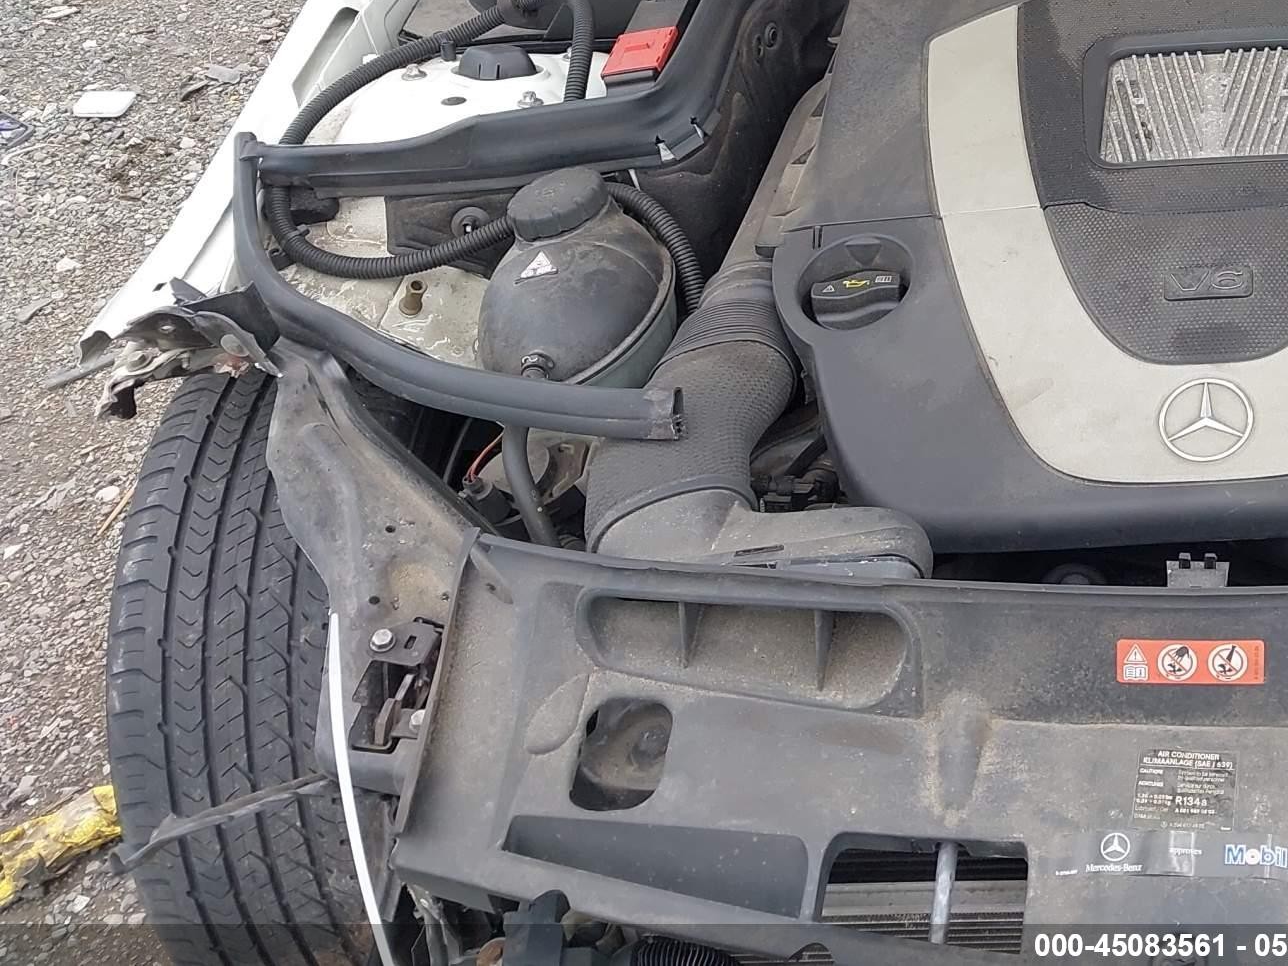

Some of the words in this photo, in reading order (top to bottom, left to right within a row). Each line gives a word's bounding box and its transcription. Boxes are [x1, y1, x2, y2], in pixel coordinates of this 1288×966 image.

[1170, 270, 1243, 291] V6
[1157, 750, 1170, 758] AIR
[1171, 751, 1220, 760] CONDITIONER
[1216, 761, 1233, 769] 639)
[1224, 843, 1288, 868] Mobil
[1085, 862, 1144, 873] Mercedes-Benz
